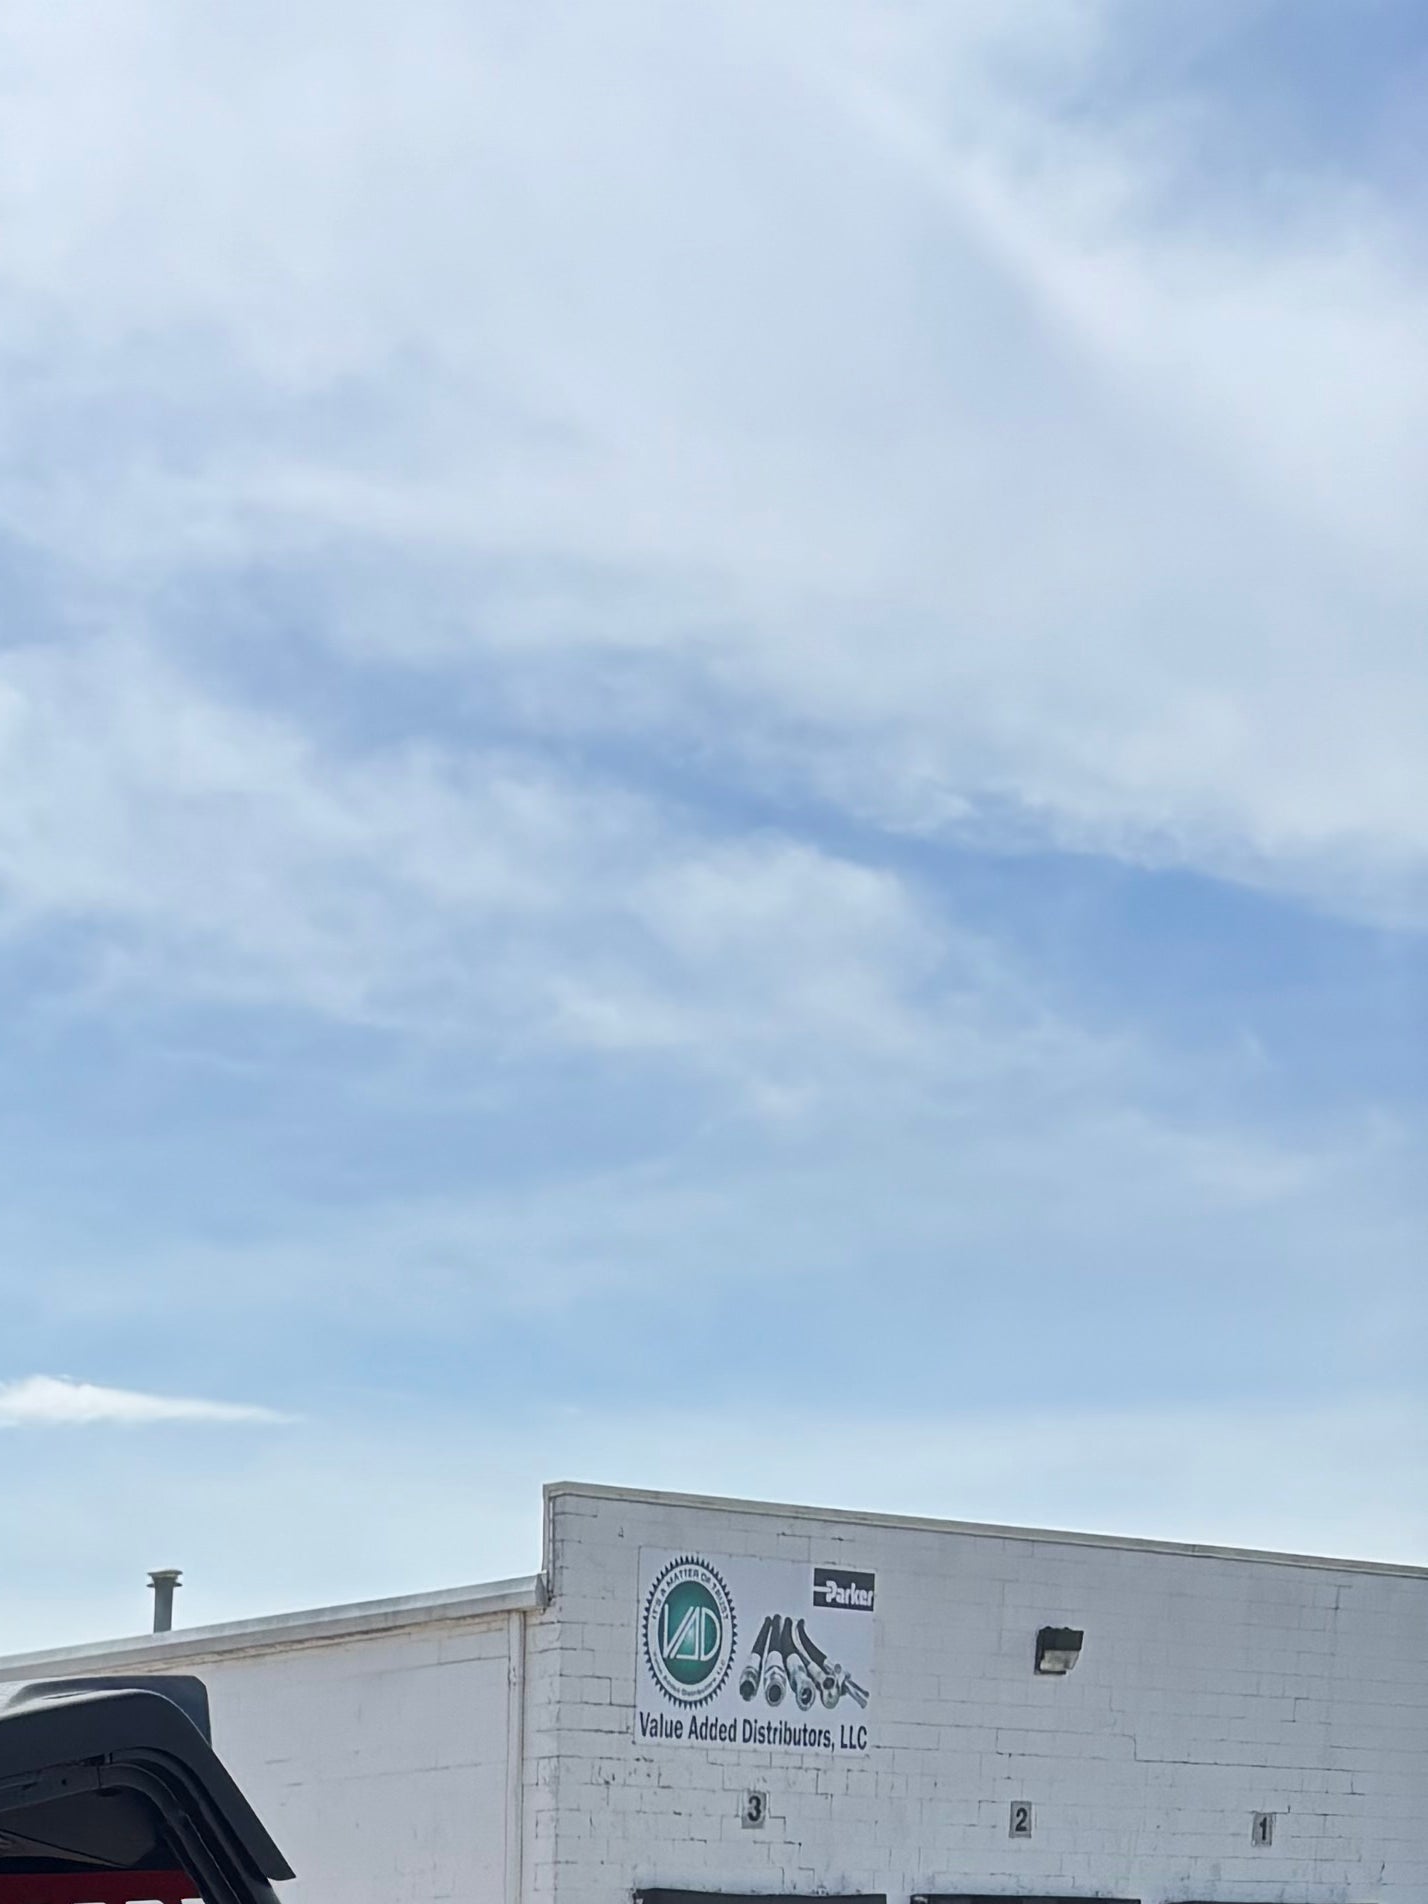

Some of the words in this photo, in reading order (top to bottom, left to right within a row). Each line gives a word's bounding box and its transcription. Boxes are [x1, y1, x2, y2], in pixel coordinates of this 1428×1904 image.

[825, 1580, 874, 1607] Parker
[662, 1603, 722, 1662] VAD
[639, 1711, 684, 1740] Value
[687, 1715, 738, 1744] Added
[742, 1718, 836, 1752] Distributors,
[840, 1724, 868, 1751] LLC
[747, 1795, 762, 1822] 3
[1015, 1806, 1028, 1832] 2
[1259, 1816, 1268, 1841] 1
